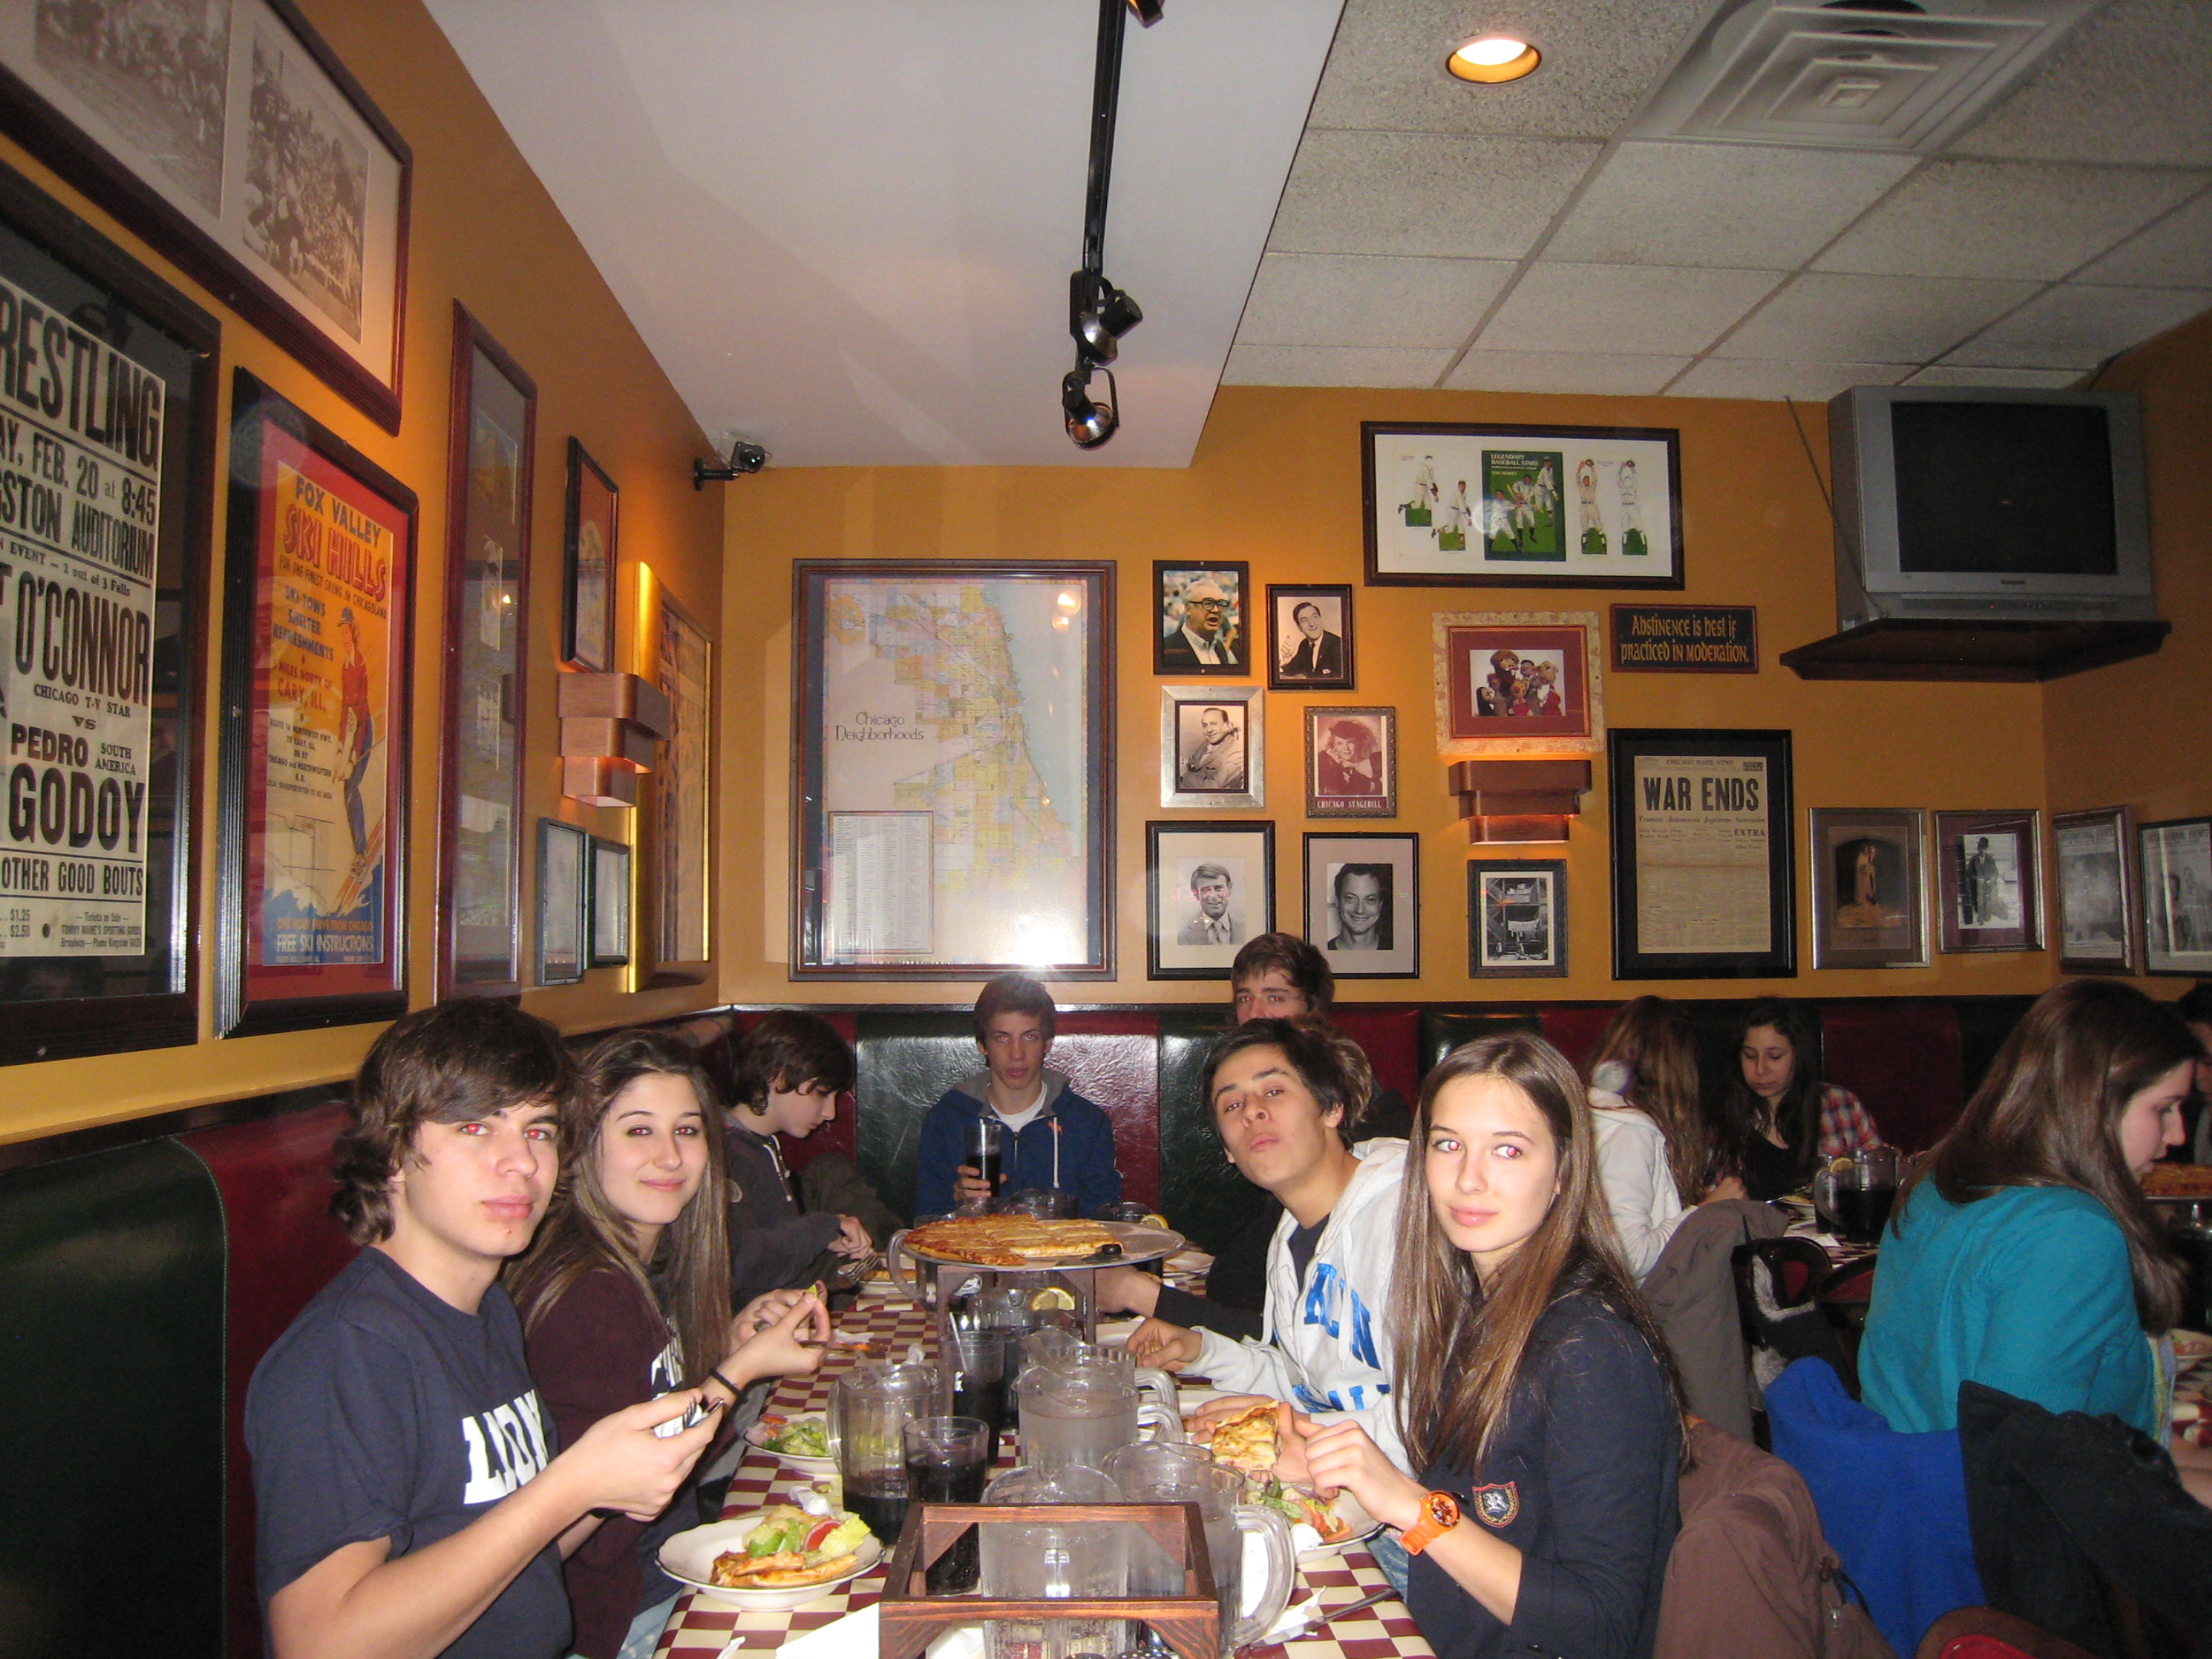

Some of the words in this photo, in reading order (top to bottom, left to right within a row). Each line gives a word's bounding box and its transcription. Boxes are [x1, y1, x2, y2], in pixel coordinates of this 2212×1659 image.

[32, 432, 69, 488] FEB.
[77, 455, 99, 500] 20
[104, 480, 115, 499] at
[122, 477, 156, 526] 8:45
[0, 469, 62, 544] STON
[72, 500, 154, 580] AUDITORIUM
[295, 474, 324, 516] FOX
[332, 498, 381, 549] VALLEY
[10, 541, 46, 565] EVENT
[111, 579, 131, 597] Falls
[282, 504, 323, 568] SKI
[328, 527, 386, 602] HILLS
[15, 571, 150, 707] O'CONNOR
[1693, 614, 1702, 637] is
[1704, 616, 1726, 637] best
[1728, 615, 1737, 639] if
[1621, 639, 1670, 664] practiced
[1673, 639, 1683, 661] in
[34, 684, 79, 706] CHICAGO
[108, 701, 131, 718] STAR
[278, 678, 307, 708] CARY,
[311, 690, 327, 713] ILL.
[835, 725, 924, 742] Neighborhoods
[855, 712, 905, 727] Chicago
[11, 723, 89, 767] PEDRO
[101, 742, 131, 760] SOUTH
[95, 757, 136, 776] AMERICA
[9, 762, 145, 853] GODOY
[1644, 777, 1691, 812] WAR
[1702, 777, 1759, 812] ENDS
[2, 857, 49, 892] OTHER
[59, 861, 95, 894] GOOD
[103, 864, 143, 896] BOUTS
[10, 909, 30, 922] $1.25
[276, 934, 297, 952] FREE
[317, 934, 374, 952] INSTRUCTIONS
